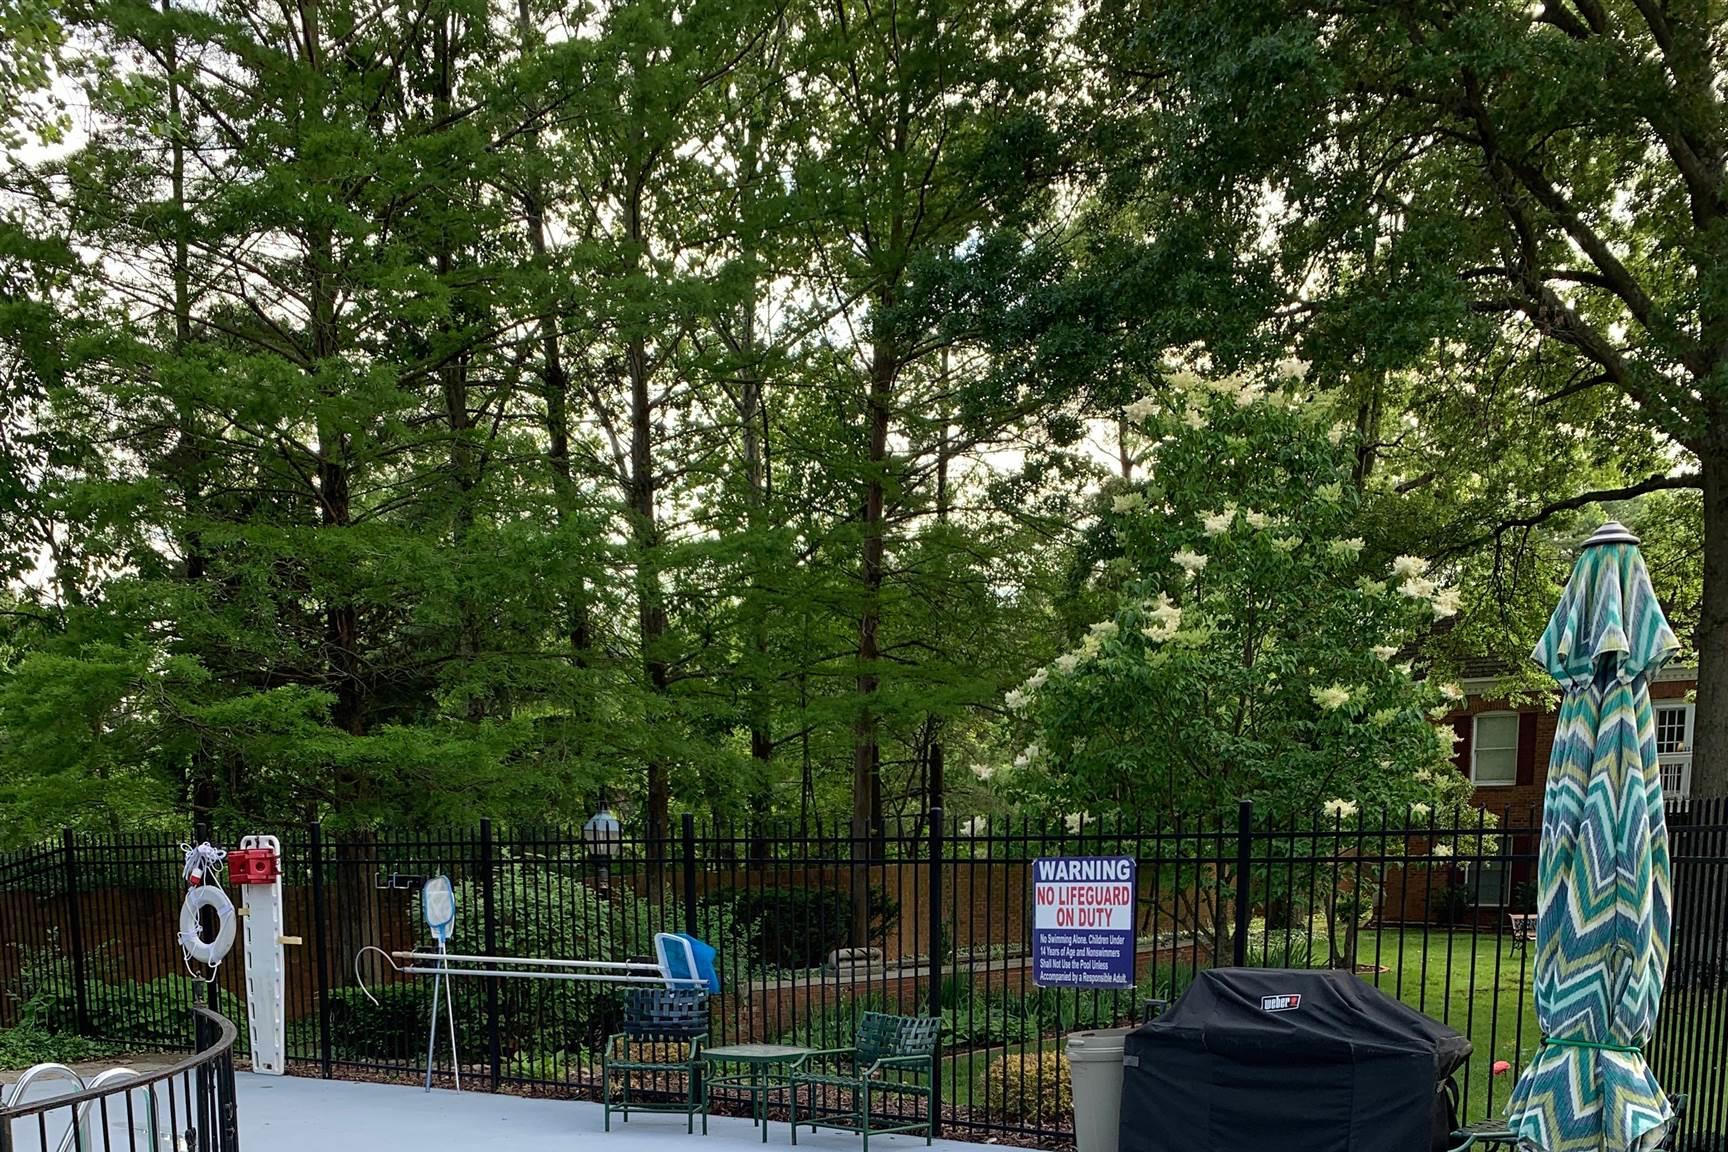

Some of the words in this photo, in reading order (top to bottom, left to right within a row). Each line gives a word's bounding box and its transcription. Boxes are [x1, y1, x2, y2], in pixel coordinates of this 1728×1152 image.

[1039, 860, 1130, 880] WARNING
[1038, 887, 1054, 905] NO
[1060, 886, 1129, 905] LIFEGUARD
[1057, 908, 1074, 926] ON
[1079, 908, 1112, 927] DUTY
[1040, 934, 1047, 944] No
[1048, 934, 1072, 946] Swimming
[1073, 934, 1087, 944] Alone.
[1088, 935, 1108, 944] Children
[1110, 935, 1125, 944] Under
[1041, 946, 1046, 955] 14
[1047, 947, 1059, 956] Years
[1061, 947, 1066, 956] of
[1066, 947, 1075, 958] Age
[1076, 947, 1085, 956] and
[1086, 947, 1120, 957] Nonswimmers
[1040, 959, 1052, 968] Shall
[1062, 959, 1070, 968] Use
[1080, 960, 1091, 969] Pool
[1092, 960, 1108, 970] Unless
[1040, 971, 1071, 983] Accompanied
[1072, 972, 1078, 984] by
[1083, 972, 1112, 984] Responsible
[1113, 973, 1127, 983] Adult.
[1265, 996, 1290, 1009] weber
